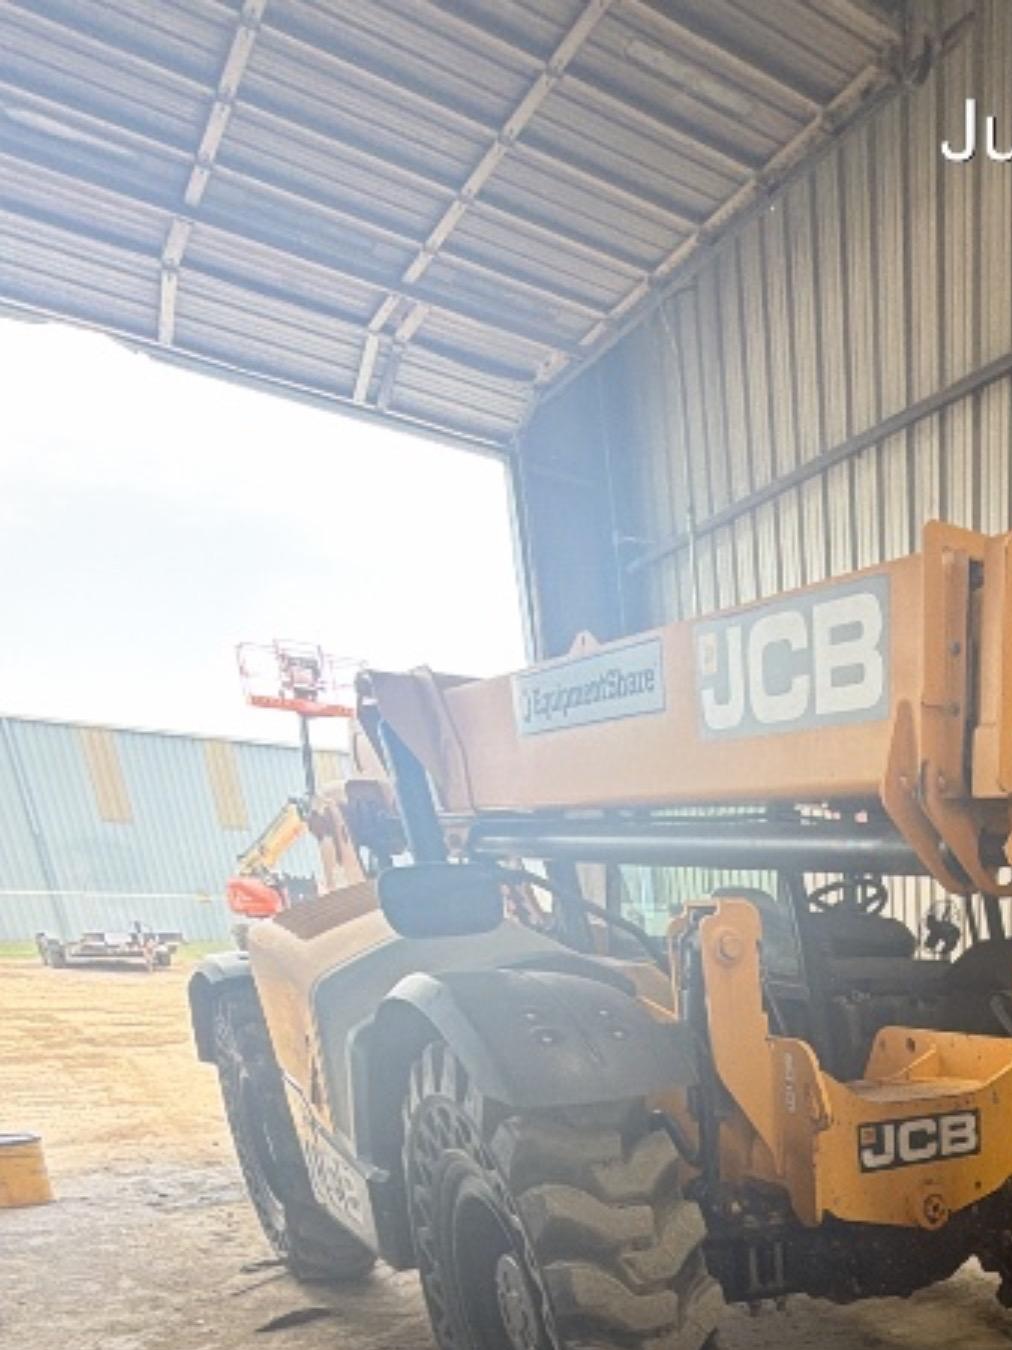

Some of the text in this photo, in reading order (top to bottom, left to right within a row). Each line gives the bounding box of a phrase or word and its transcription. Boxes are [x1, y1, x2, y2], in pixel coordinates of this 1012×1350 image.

[700, 592, 882, 729] JCB
[532, 667, 656, 720] EquipmentShare
[861, 1112, 978, 1169] JCB
